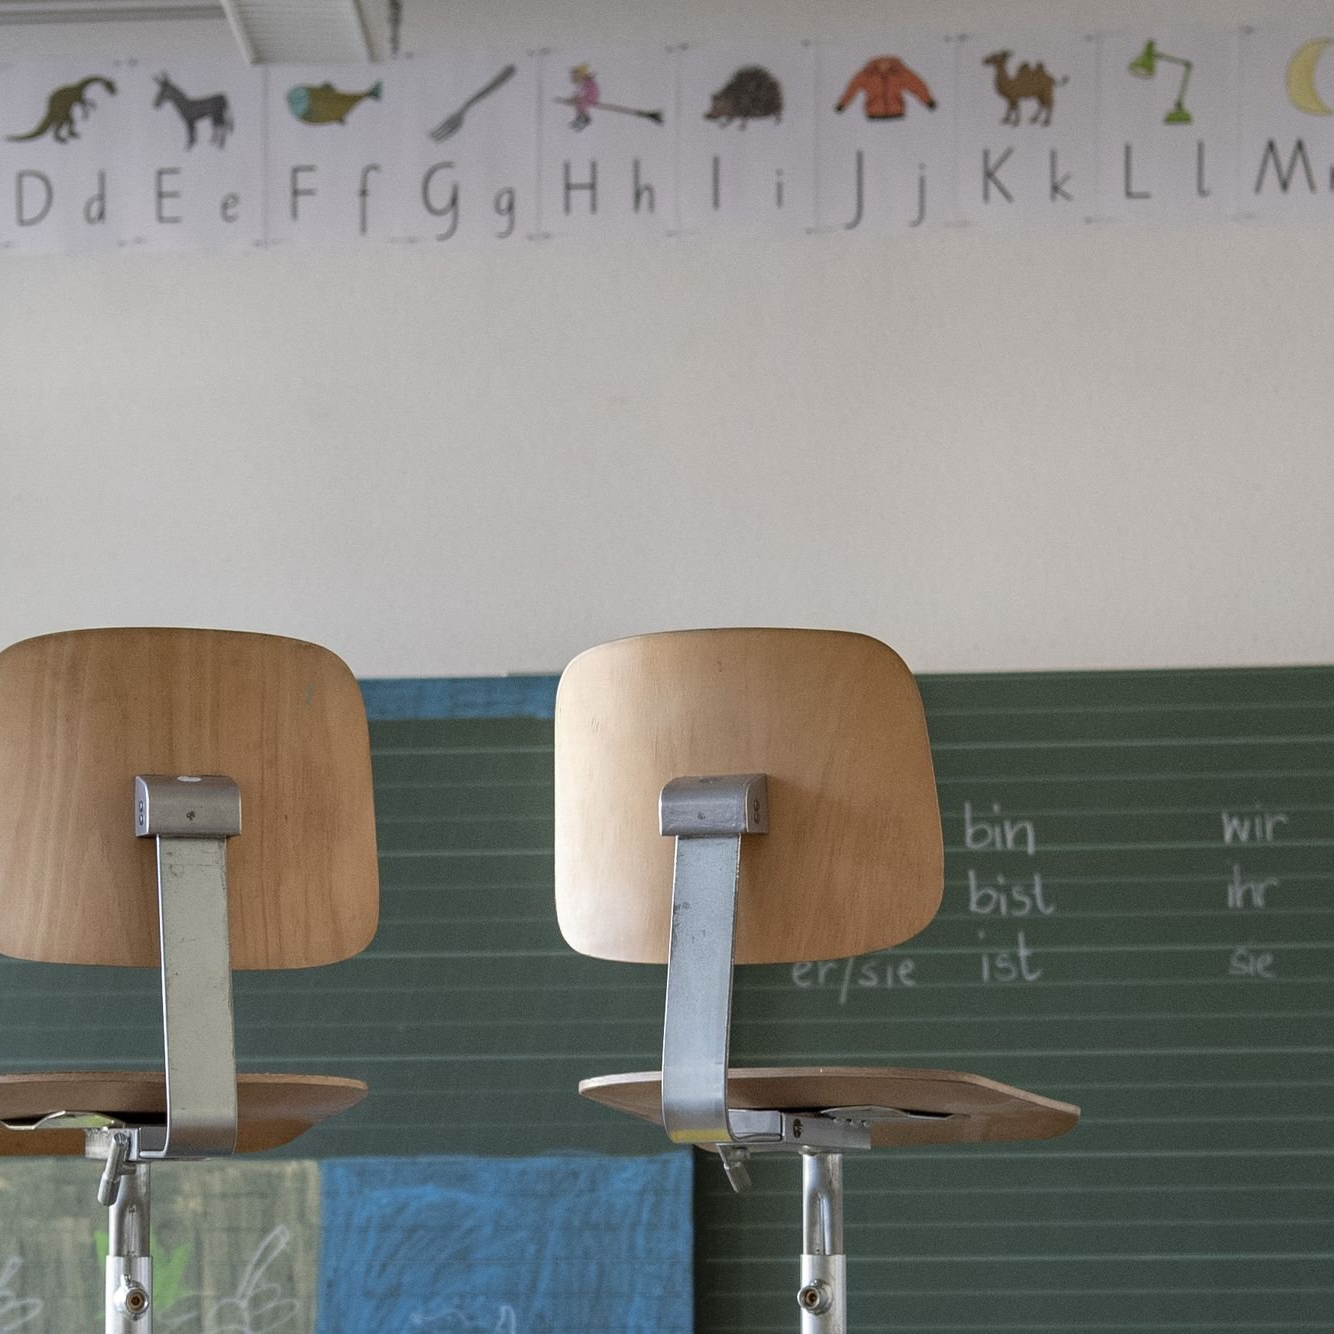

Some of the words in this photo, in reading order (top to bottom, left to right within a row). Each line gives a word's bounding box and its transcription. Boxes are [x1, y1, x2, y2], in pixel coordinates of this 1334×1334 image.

[16, 169, 53, 226] D
[84, 172, 106, 223] d
[156, 167, 181, 223] E
[221, 192, 241, 223] e
[290, 165, 317, 220] F
[357, 163, 380, 235] f
[421, 162, 459, 241] G
[494, 187, 515, 238] g
[564, 160, 597, 214] H
[634, 159, 655, 212] h
[775, 169, 782, 209] i
[845, 149, 863, 230] J
[909, 162, 926, 227] j
[983, 148, 1013, 202] K
[1050, 149, 1073, 201] k
[1125, 143, 1151, 198] L
[1198, 139, 1211, 196] l
[964, 801, 1035, 856] bin
[1222, 801, 1290, 845] wir
[967, 868, 1054, 916] bist
[1228, 863, 1279, 908] ihr
[979, 929, 1043, 982] ist
[1229, 947, 1275, 977] sie
